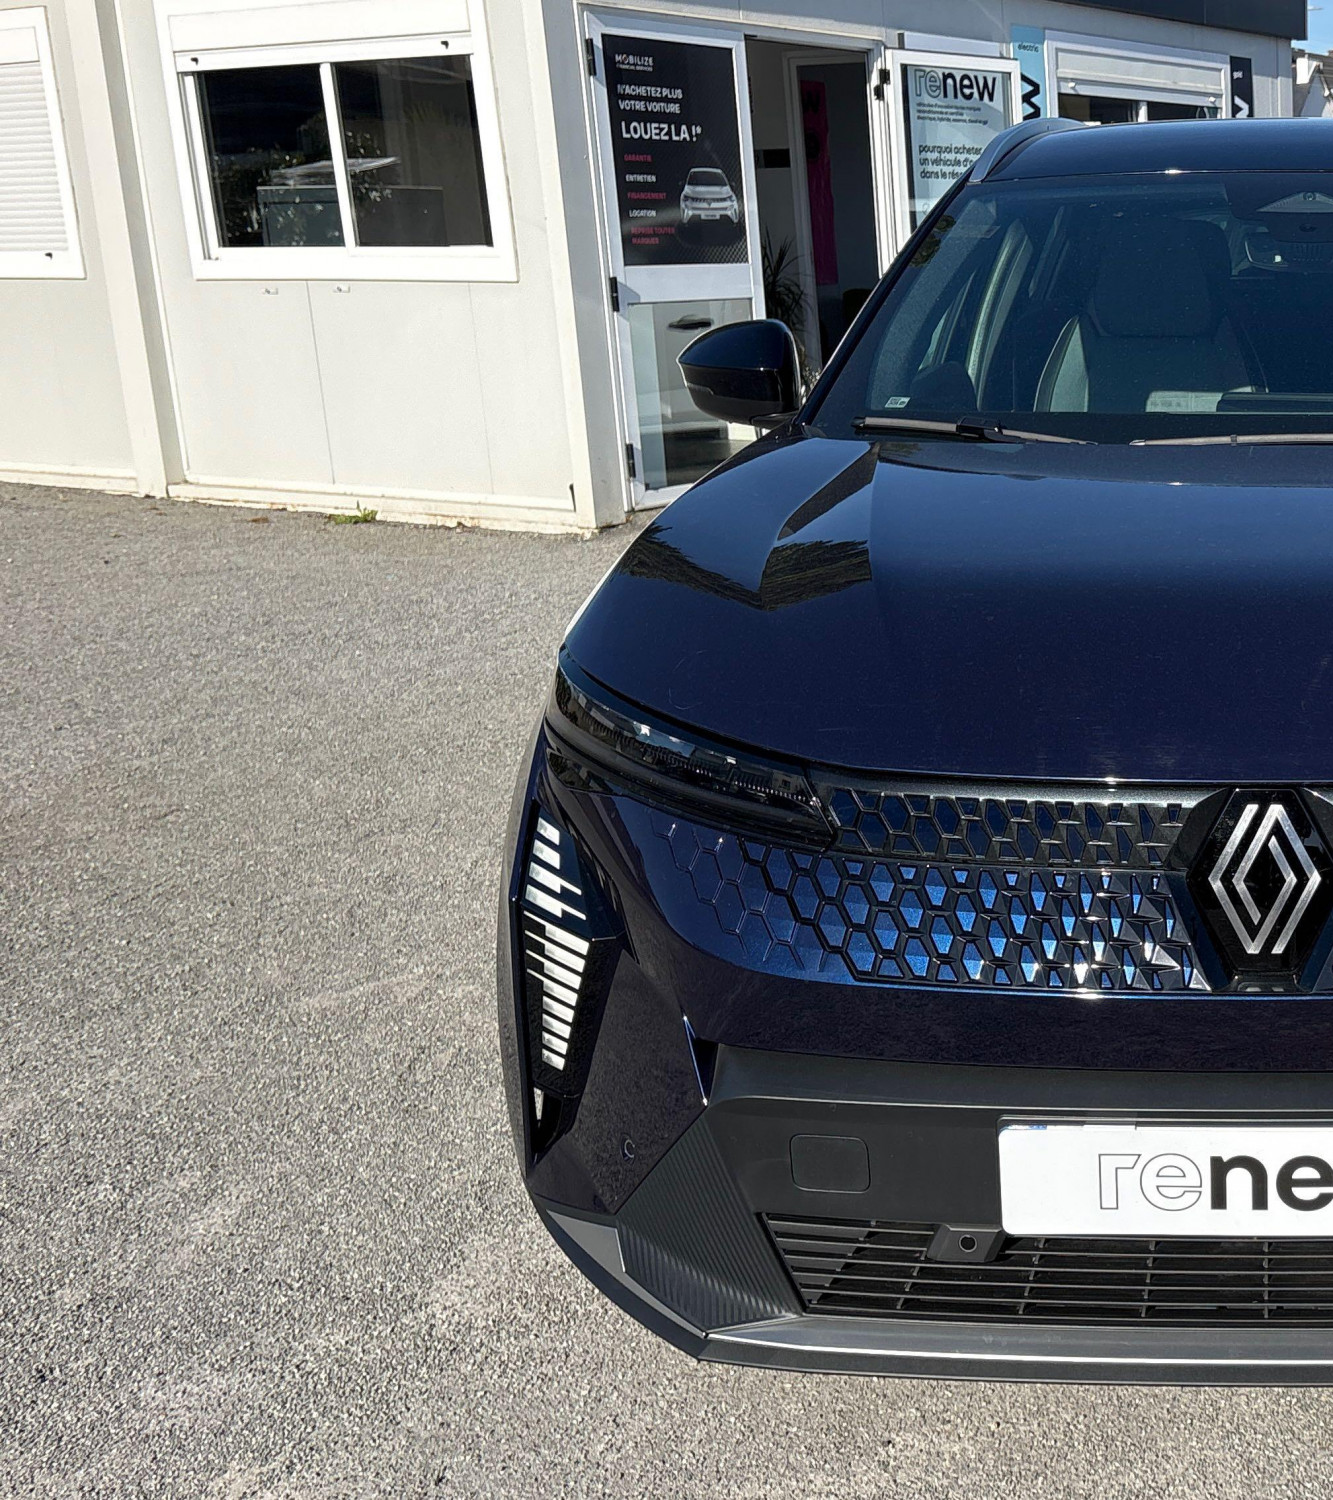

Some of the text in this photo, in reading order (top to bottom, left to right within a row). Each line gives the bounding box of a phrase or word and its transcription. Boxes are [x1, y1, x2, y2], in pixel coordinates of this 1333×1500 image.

[615, 53, 654, 66] MOBILIZE
[617, 84, 683, 99] N'ACHETEZ PLUS
[914, 68, 997, 102] renew
[618, 99, 681, 114] VOTRE VOITURE
[621, 121, 669, 140] LOUEZ
[671, 123, 690, 142] LA
[918, 144, 952, 157] pourquoi
[919, 157, 929, 167] un
[930, 155, 962, 168] véhicule
[920, 167, 939, 180] dans
[940, 168, 948, 180] le
[629, 208, 657, 218] LOCATION
